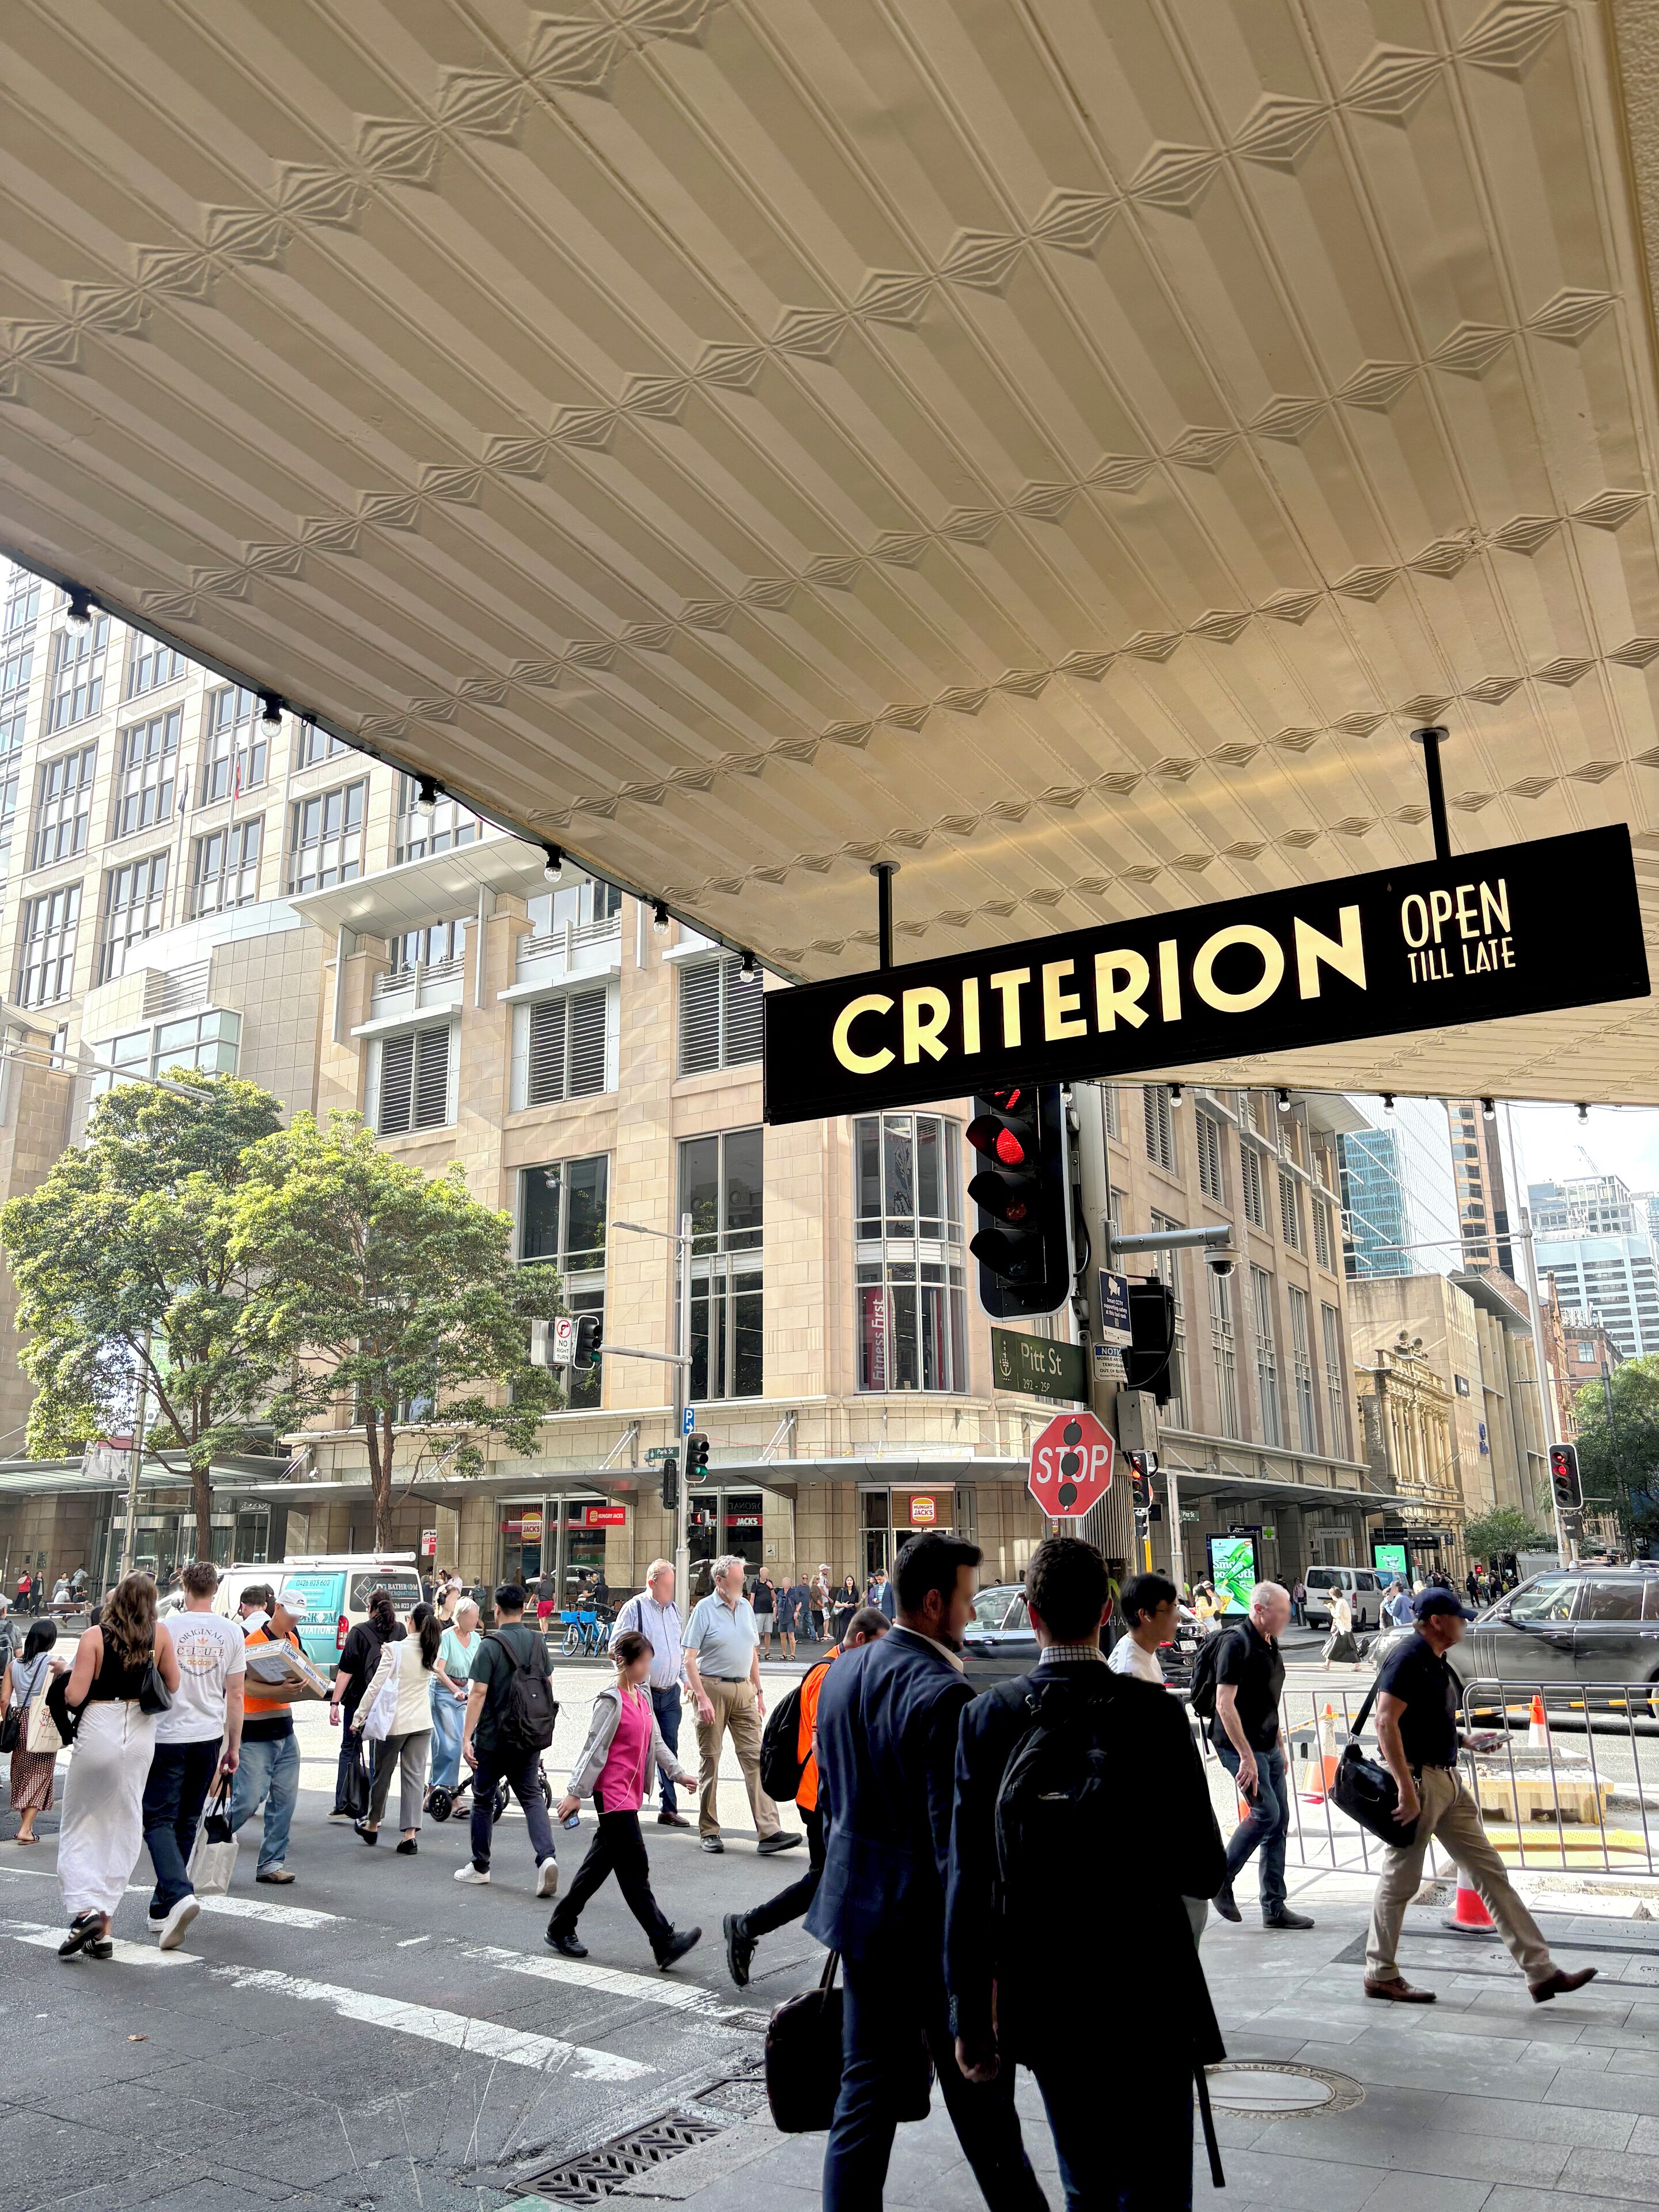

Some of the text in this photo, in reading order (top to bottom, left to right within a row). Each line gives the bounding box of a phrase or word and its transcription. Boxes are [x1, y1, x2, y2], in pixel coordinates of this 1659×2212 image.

[1401, 878, 1511, 948] OPEN
[1407, 937, 1516, 983] TILL LATE
[832, 905, 1366, 1074] CRITERION
[1021, 1342, 1062, 1376] Pitt St
[1101, 1348, 1122, 1356] NOTIC
[1022, 1378, 1033, 1390] 292
[685, 1410, 693, 1423] P
[1036, 1444, 1109, 1484] STOP
[179, 1628, 225, 1645] ORIGINALS
